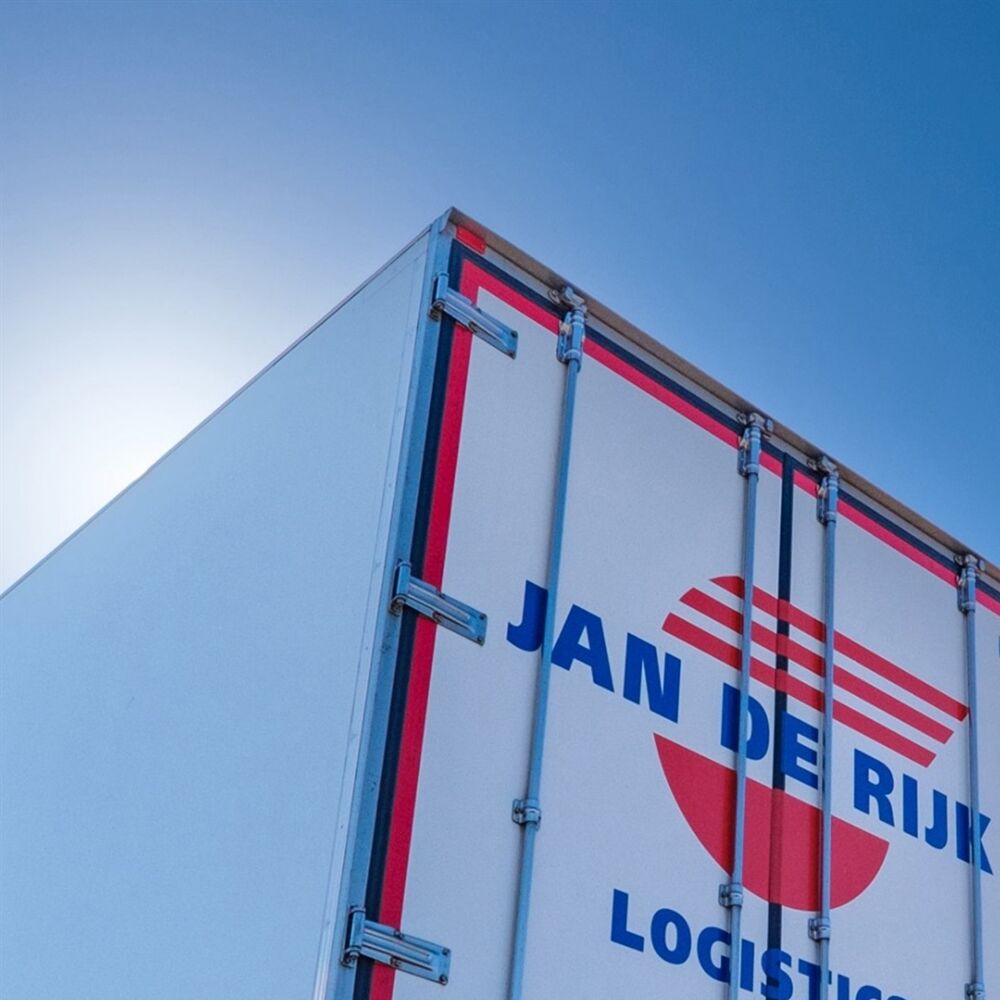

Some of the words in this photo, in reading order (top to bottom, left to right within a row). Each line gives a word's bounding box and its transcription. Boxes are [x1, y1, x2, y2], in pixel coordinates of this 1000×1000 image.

[507, 580, 681, 724] JAN
[721, 682, 825, 792] DE
[853, 747, 993, 876] RIJK
